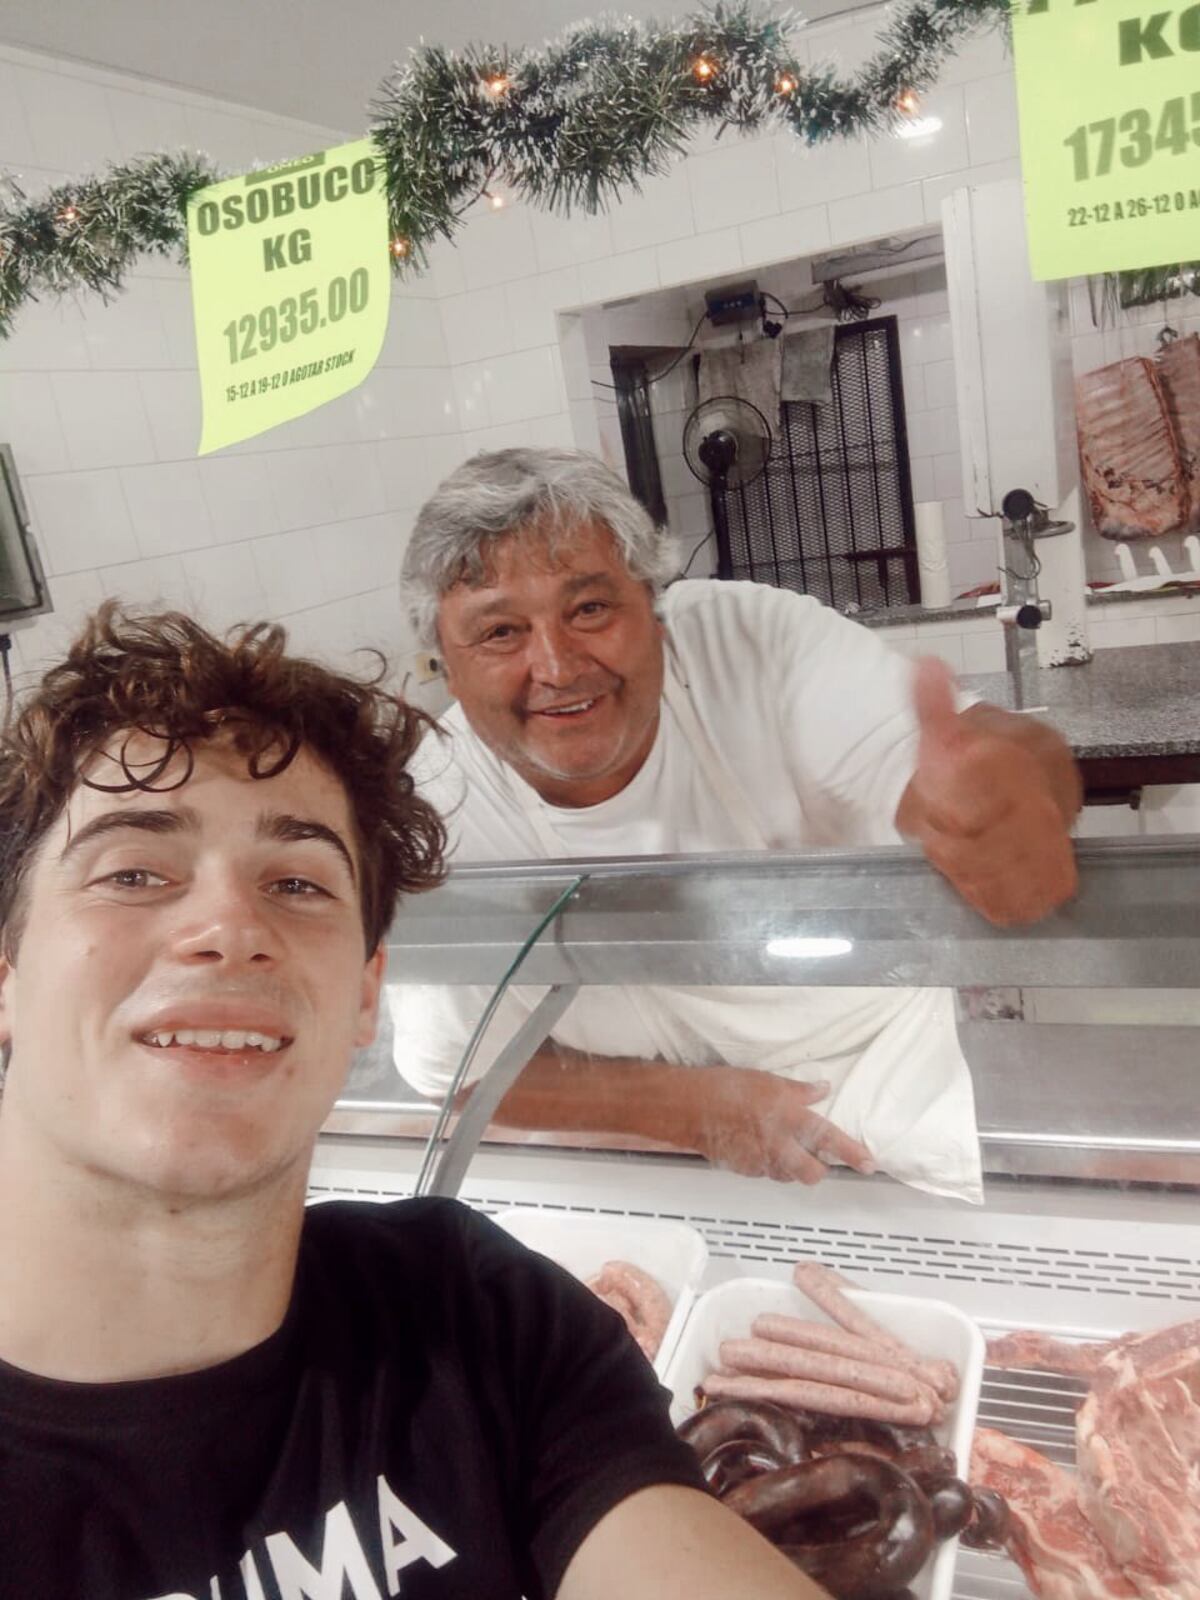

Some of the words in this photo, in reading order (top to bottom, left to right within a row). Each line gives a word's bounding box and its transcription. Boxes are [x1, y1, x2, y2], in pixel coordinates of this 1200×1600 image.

[197, 157, 376, 236] OSOBUCO
[1067, 203, 1111, 227] 22-12
[1114, 201, 1125, 221] A
[1126, 193, 1171, 218] 26-12
[1188, 189, 1200, 209] A
[262, 228, 312, 273] KG
[223, 266, 370, 365] 12935.00
[226, 382, 249, 402] 15-12
[250, 379, 257, 397] A
[258, 372, 281, 394] 19-12
[289, 359, 325, 385] AGOTAR
[324, 348, 357, 373] STOCK
[145, 1474, 458, 1600] MA
